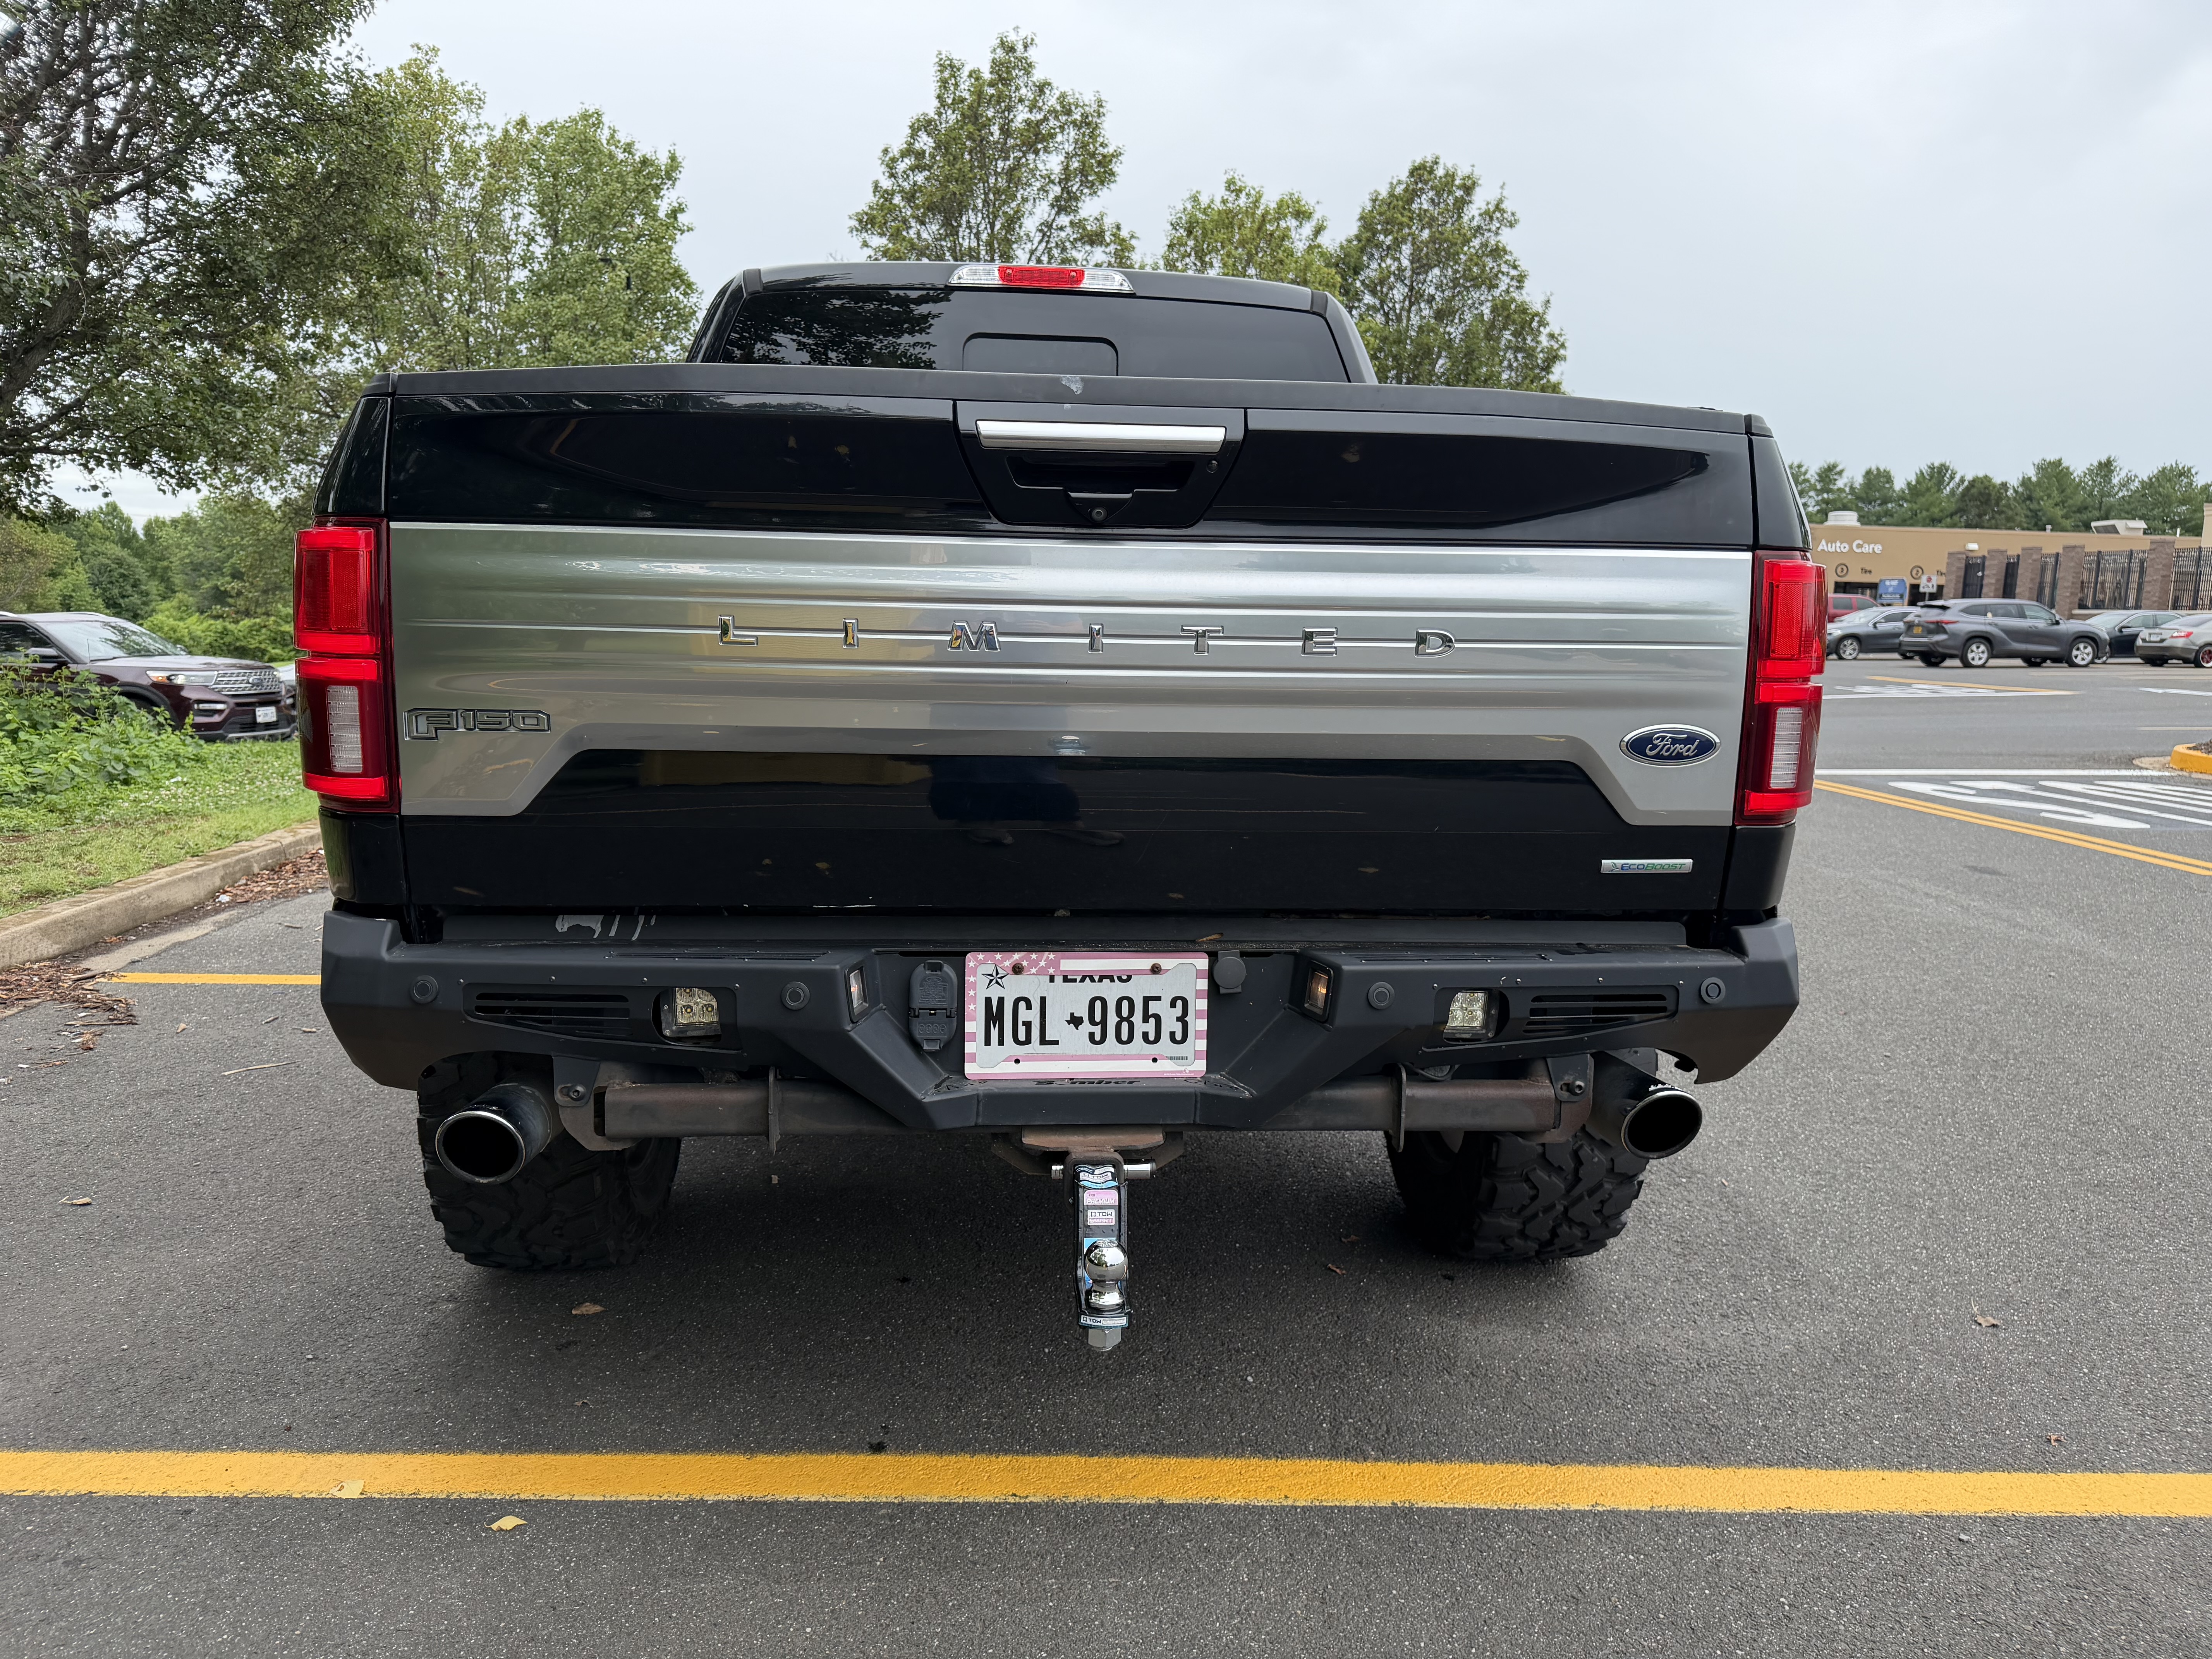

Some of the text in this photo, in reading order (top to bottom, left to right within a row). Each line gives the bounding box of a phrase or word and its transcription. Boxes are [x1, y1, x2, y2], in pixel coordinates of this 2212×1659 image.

[1817, 538, 1882, 554] Auto Care
[718, 614, 1455, 658] LIMITED
[403, 708, 551, 740] F150
[1645, 733, 1700, 757] Ford
[984, 995, 1189, 1046] MGL 9853
